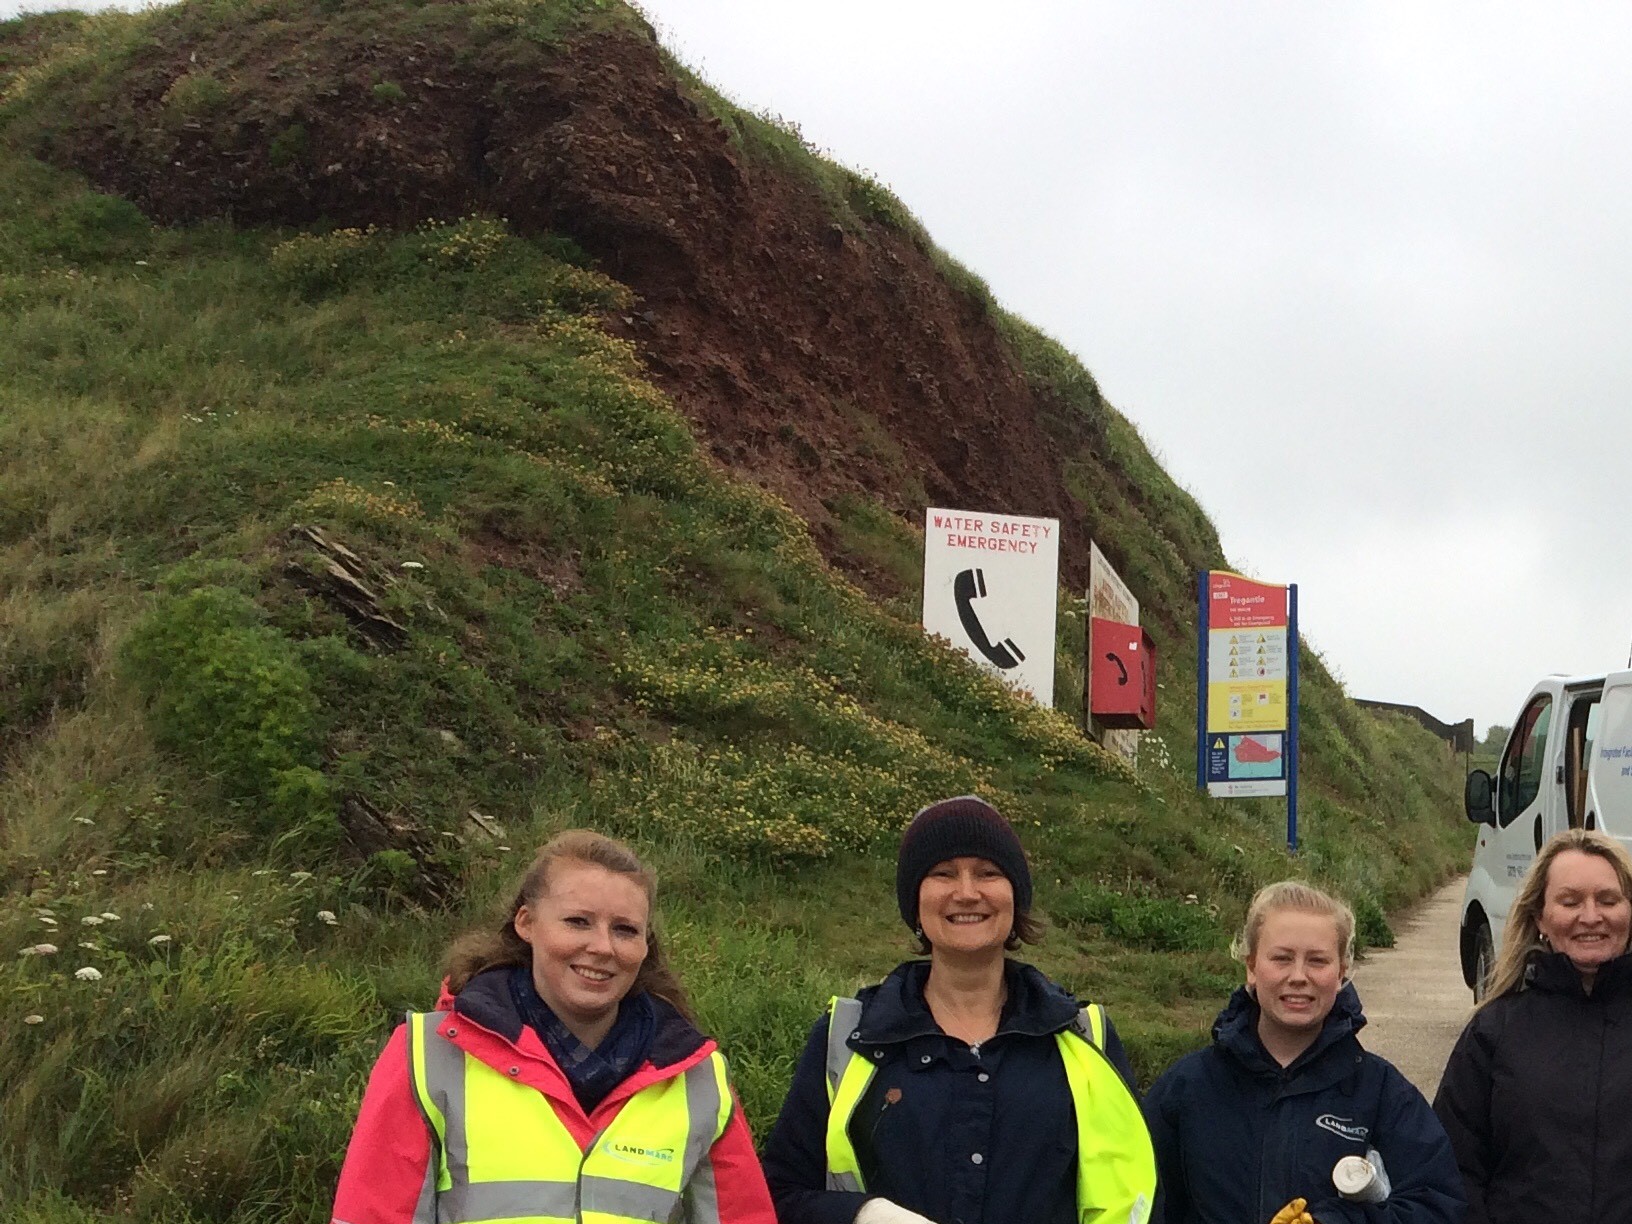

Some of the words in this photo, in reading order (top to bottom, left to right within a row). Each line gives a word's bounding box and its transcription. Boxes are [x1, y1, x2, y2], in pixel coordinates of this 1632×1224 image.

[934, 516, 983, 532] WATER
[991, 521, 1050, 539] SAFETY
[947, 534, 1037, 554] EMERGENCY
[615, 1144, 673, 1162] LANDMARC
